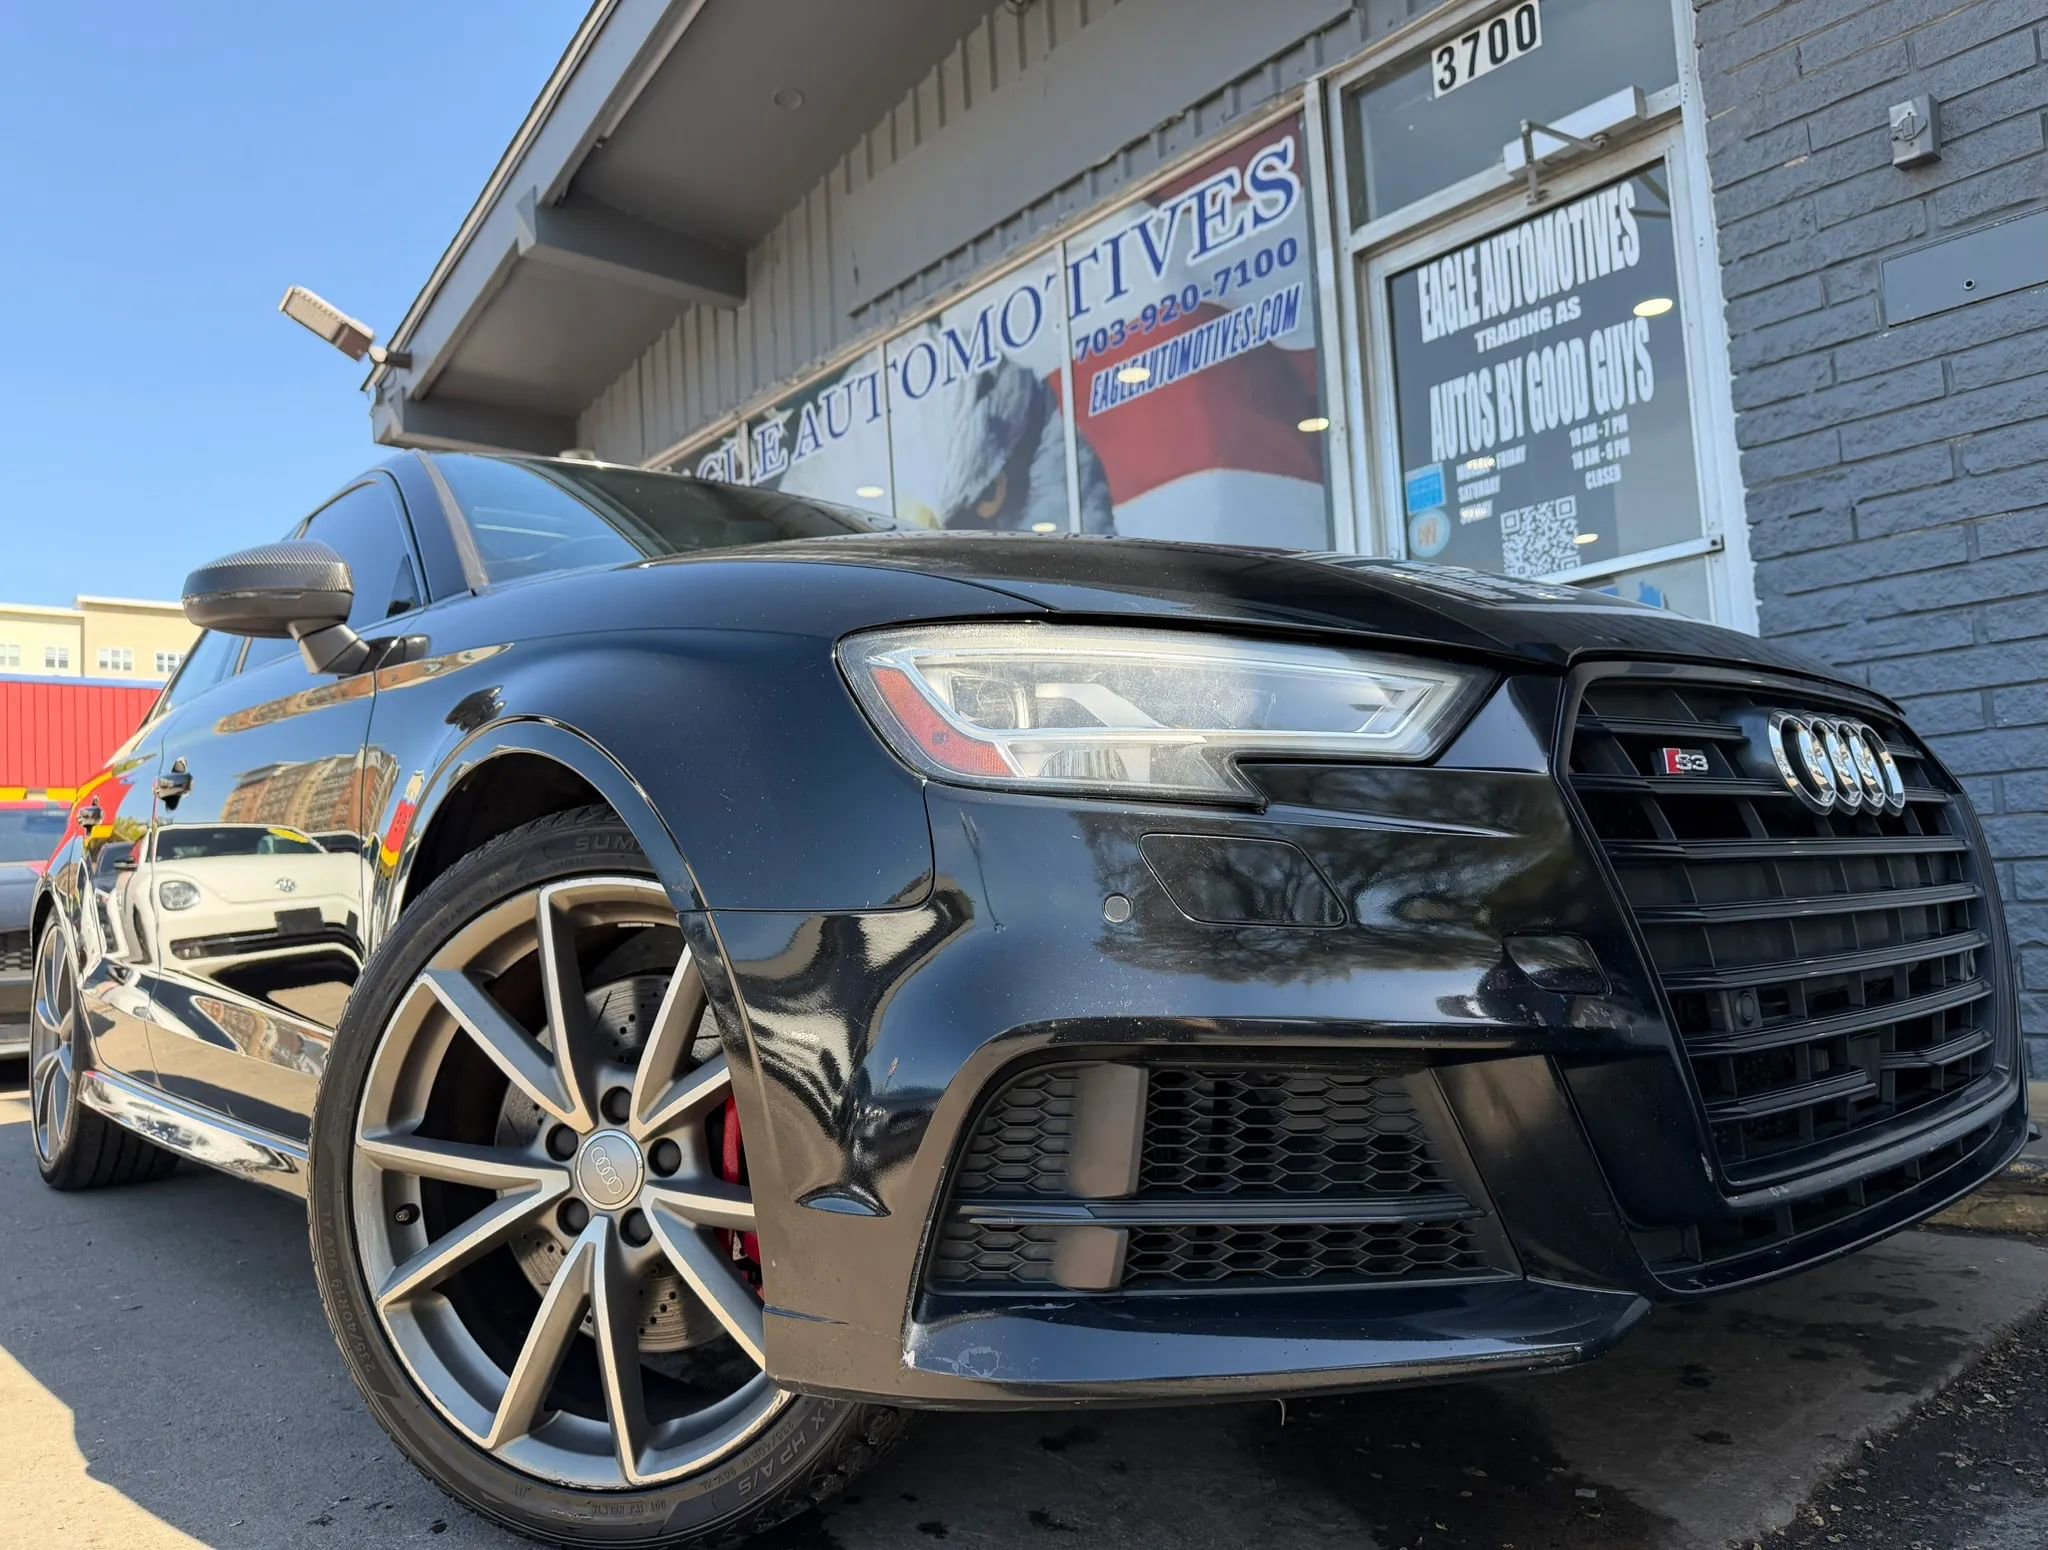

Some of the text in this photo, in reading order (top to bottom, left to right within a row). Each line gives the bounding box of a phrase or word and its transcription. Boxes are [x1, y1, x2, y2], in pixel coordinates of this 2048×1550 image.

[1436, 3, 1537, 91] 3700
[1417, 181, 1641, 344] EAGLE AUTOMOTIVES
[792, 135, 1300, 463] AUTOMOTIVES
[1075, 237, 1299, 364] 703-920-7100
[1473, 296, 1582, 353] TRADING AS
[1088, 281, 1304, 418] EAGLEAUTOMOTIVES.COM
[1430, 316, 1655, 462] AUTOS BY GOOD GUYS
[1611, 413, 1629, 436] PM
[1613, 436, 1631, 459] PM
[1584, 463, 1622, 490] CLOSED
[1675, 753, 1709, 771] S3
[575, 835, 640, 851] SUM
[779, 1430, 808, 1465] HP
[737, 1458, 775, 1496] A/S
